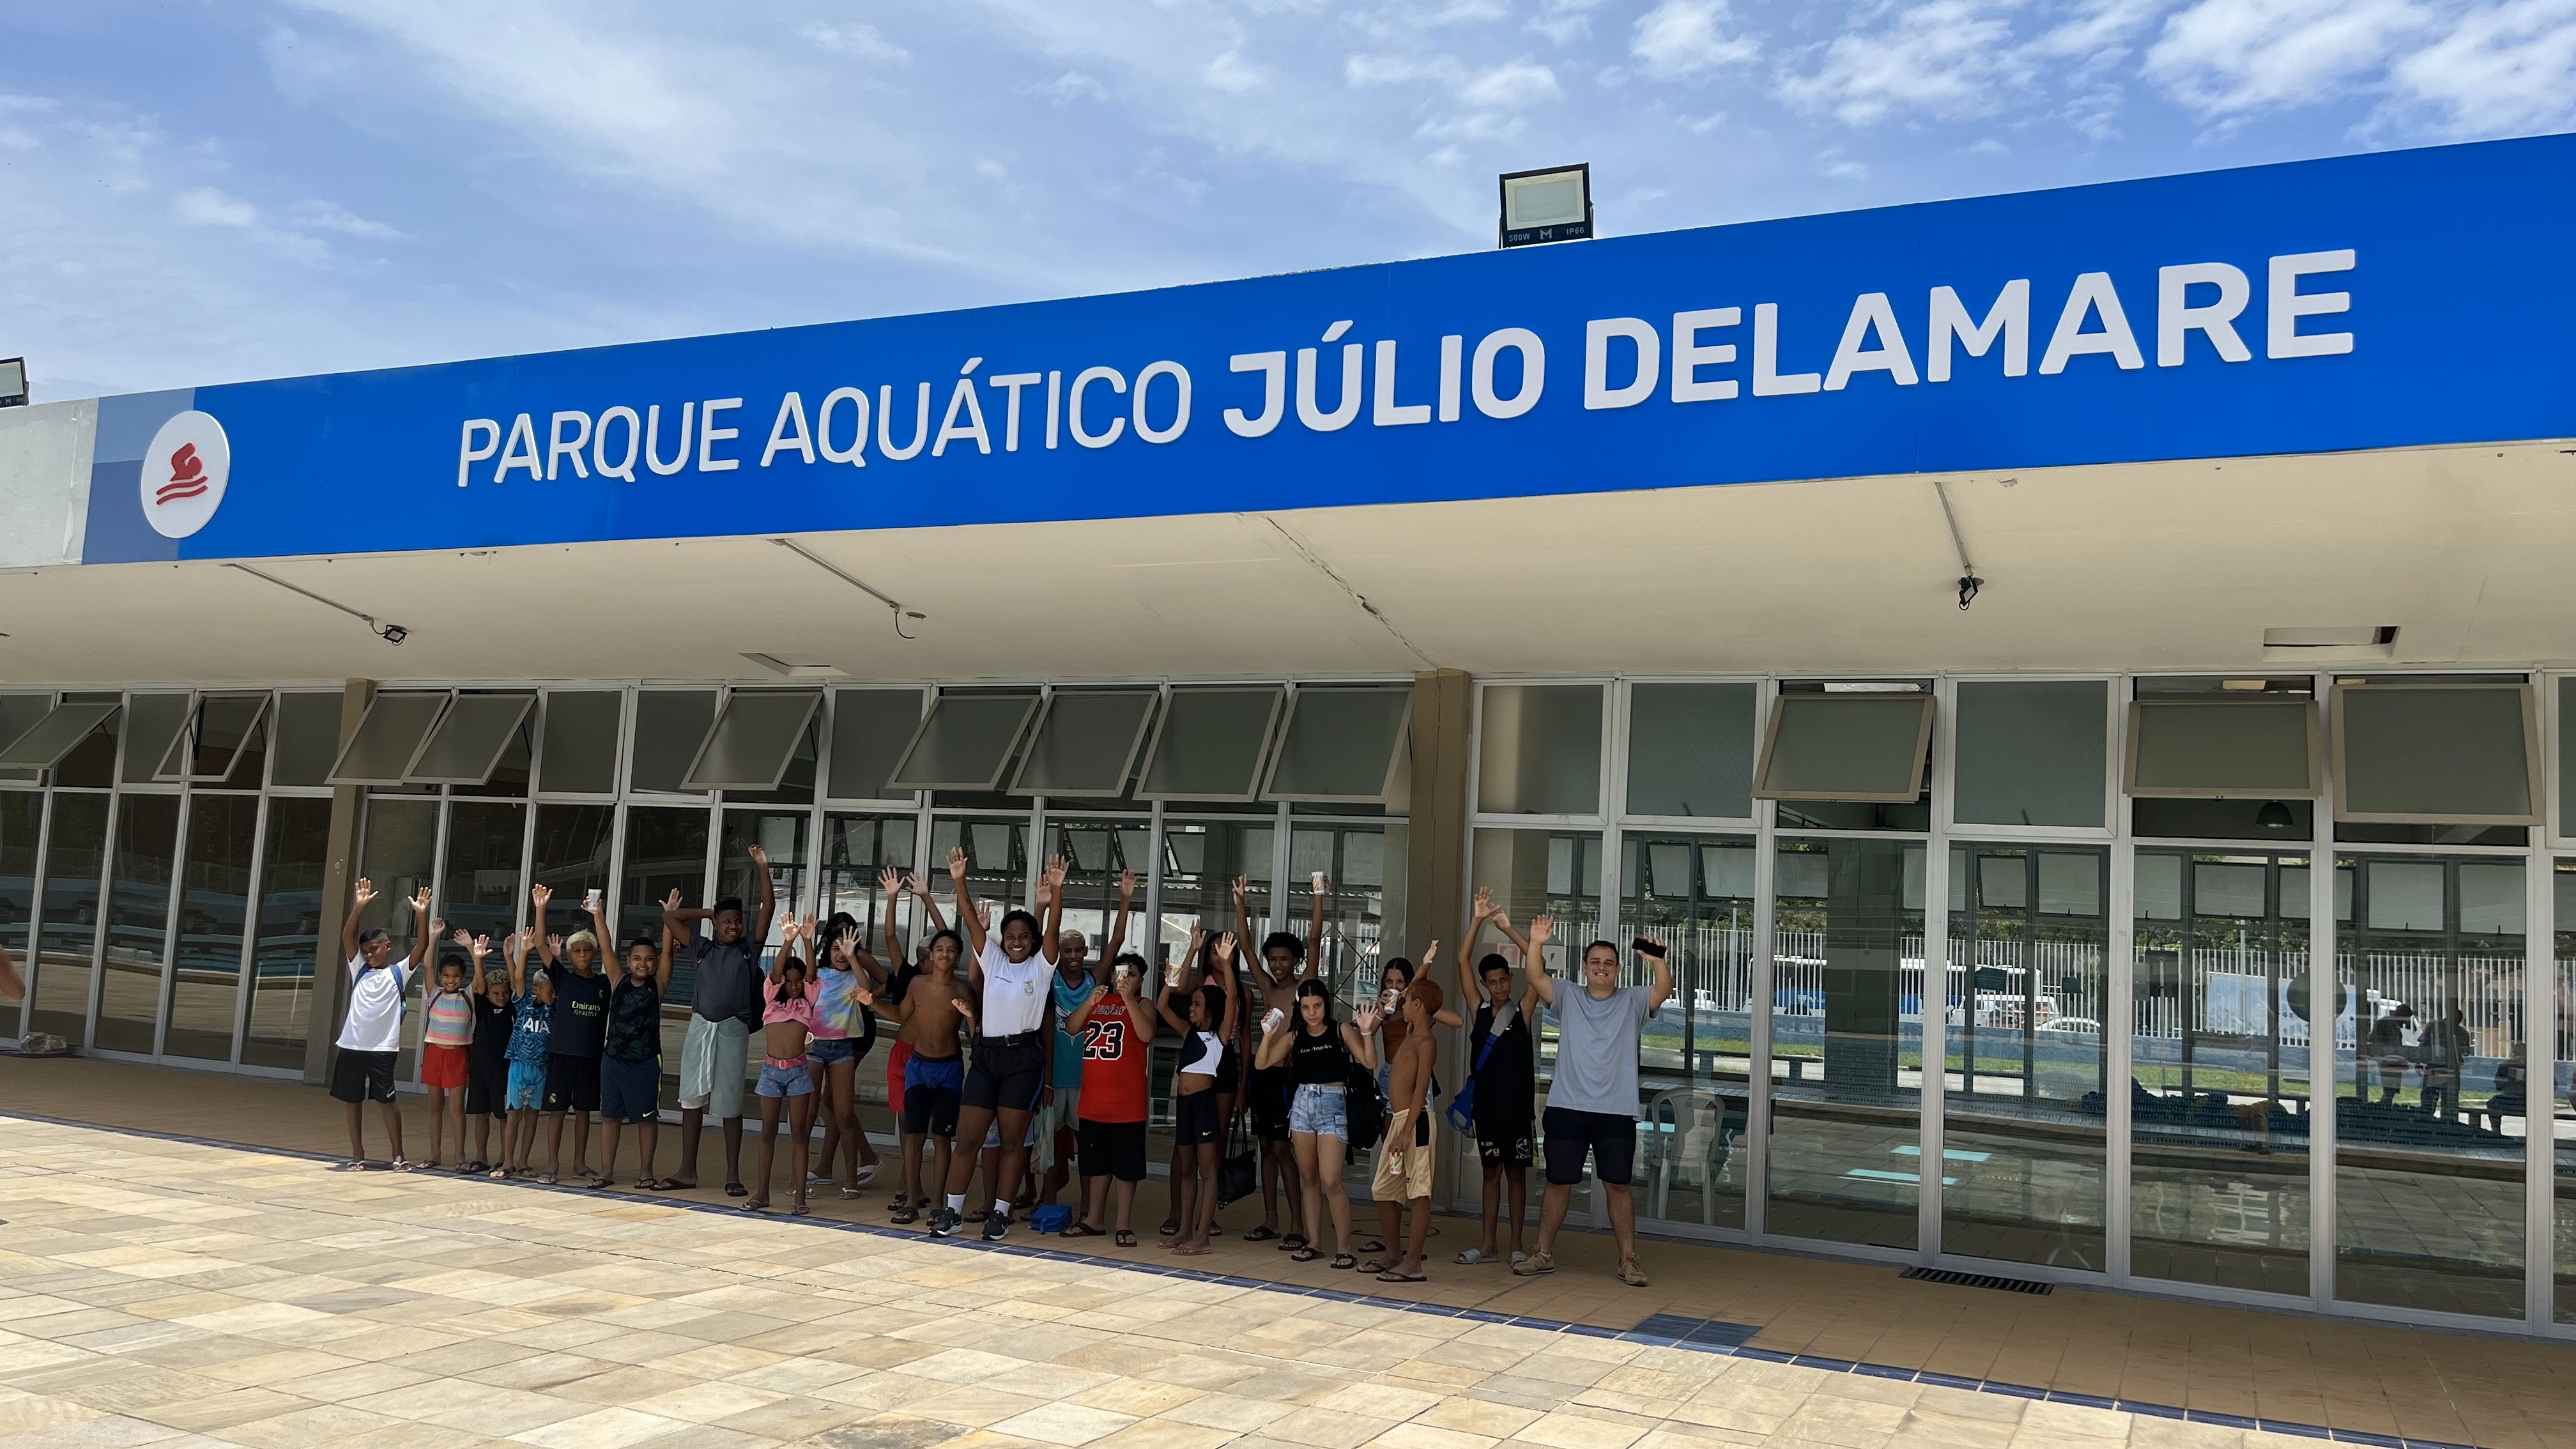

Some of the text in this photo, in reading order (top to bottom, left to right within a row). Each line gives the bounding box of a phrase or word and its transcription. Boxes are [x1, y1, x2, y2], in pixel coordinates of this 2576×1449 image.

[1508, 233, 1531, 242] 500W
[1566, 226, 1584, 236] IP66
[456, 248, 2356, 487] PARQUE AQUÁTICO JÚLIO DELAMARE
[571, 1000, 601, 1011] Emirates
[523, 1017, 551, 1034] AIA
[1082, 1020, 1126, 1061] 23
